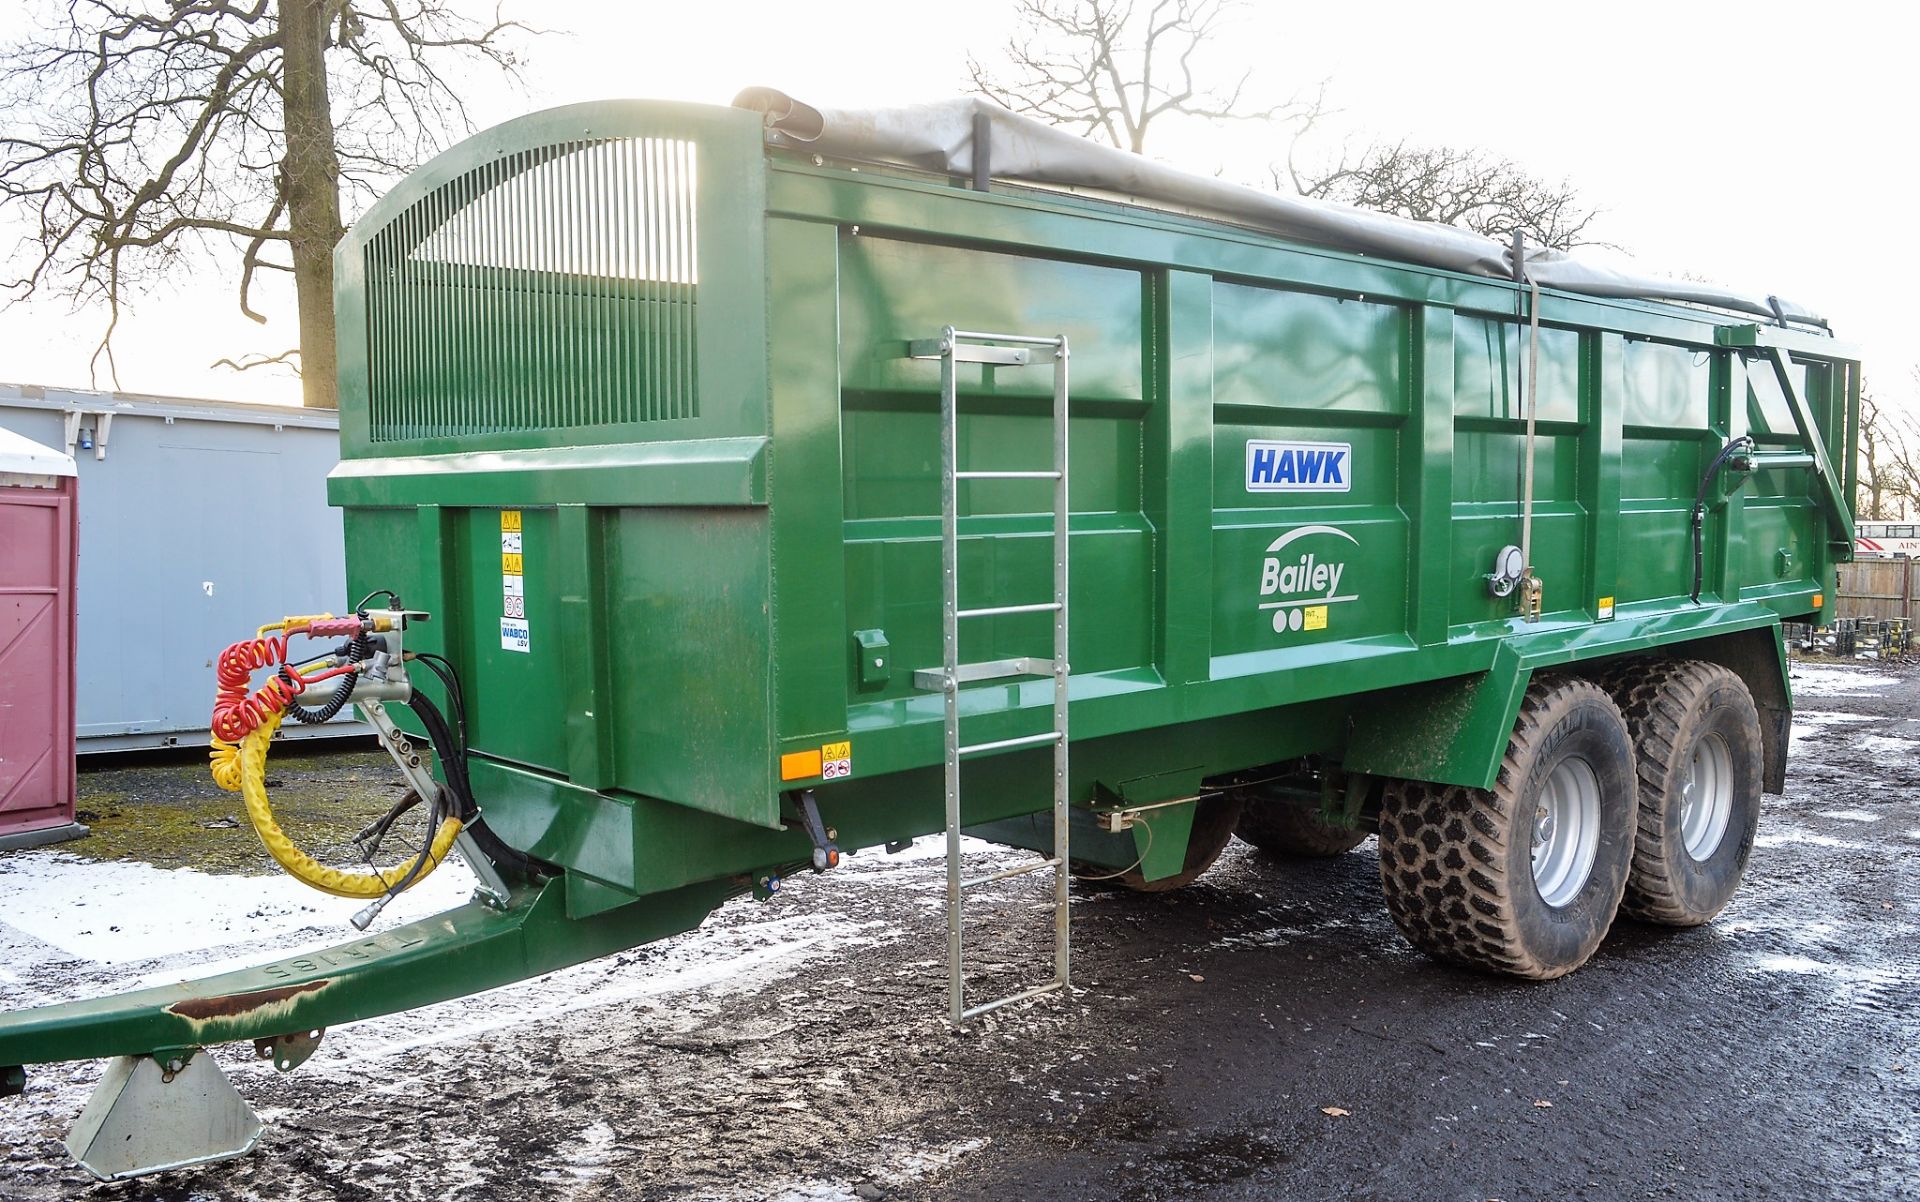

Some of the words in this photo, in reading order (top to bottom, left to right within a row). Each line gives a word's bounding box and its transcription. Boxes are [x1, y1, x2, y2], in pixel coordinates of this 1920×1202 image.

[1251, 449, 1346, 484] HAWK
[1898, 541, 1920, 549] AIN
[1260, 554, 1344, 599] Bailey
[502, 627, 528, 640] WABCO
[517, 640, 528, 648] LSV
